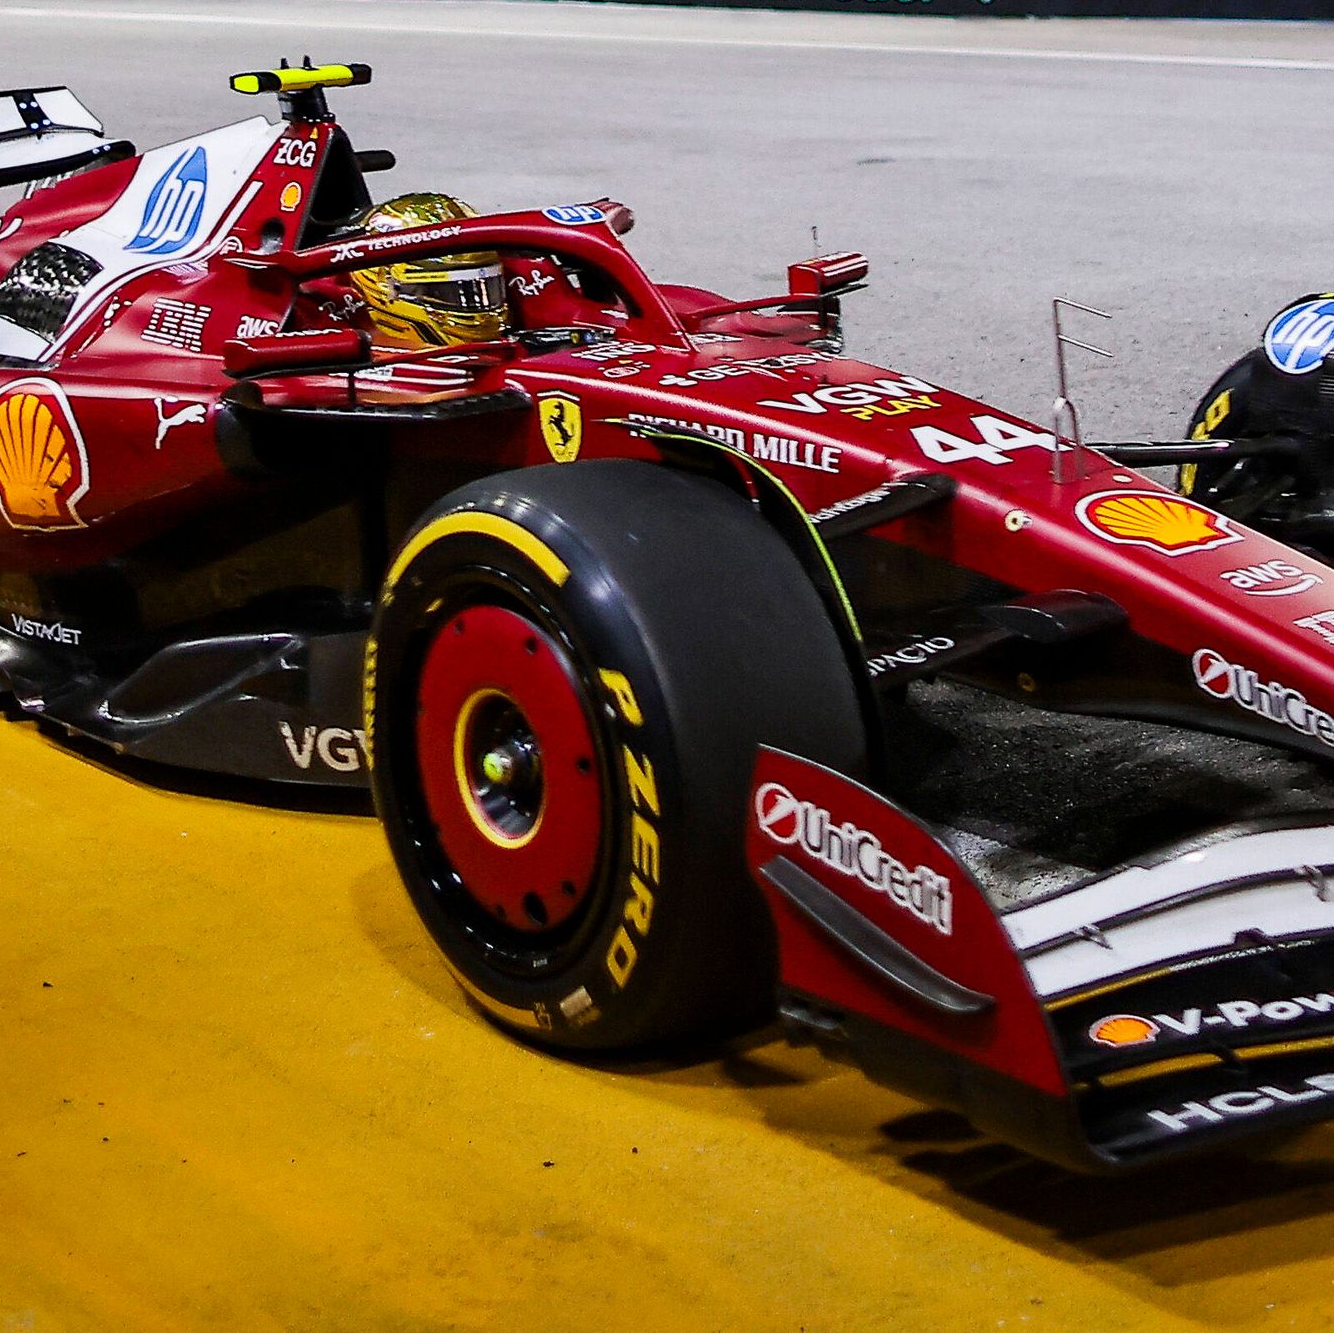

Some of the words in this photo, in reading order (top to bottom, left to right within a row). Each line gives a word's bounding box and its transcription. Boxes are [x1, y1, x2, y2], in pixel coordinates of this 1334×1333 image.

[273, 137, 318, 168] ZCG
[135, 146, 208, 254] hp
[366, 224, 465, 252] TECHNOLOGY
[140, 296, 212, 353] IBM
[236, 315, 281, 339] aws
[756, 375, 940, 416] VGW
[840, 395, 942, 421] PLAY
[752, 433, 843, 474] MILLE
[909, 414, 1074, 466] 44
[1219, 559, 1307, 591] aws
[598, 667, 646, 728] P
[605, 743, 661, 989] ZERO
[799, 800, 953, 936] UniCredit
